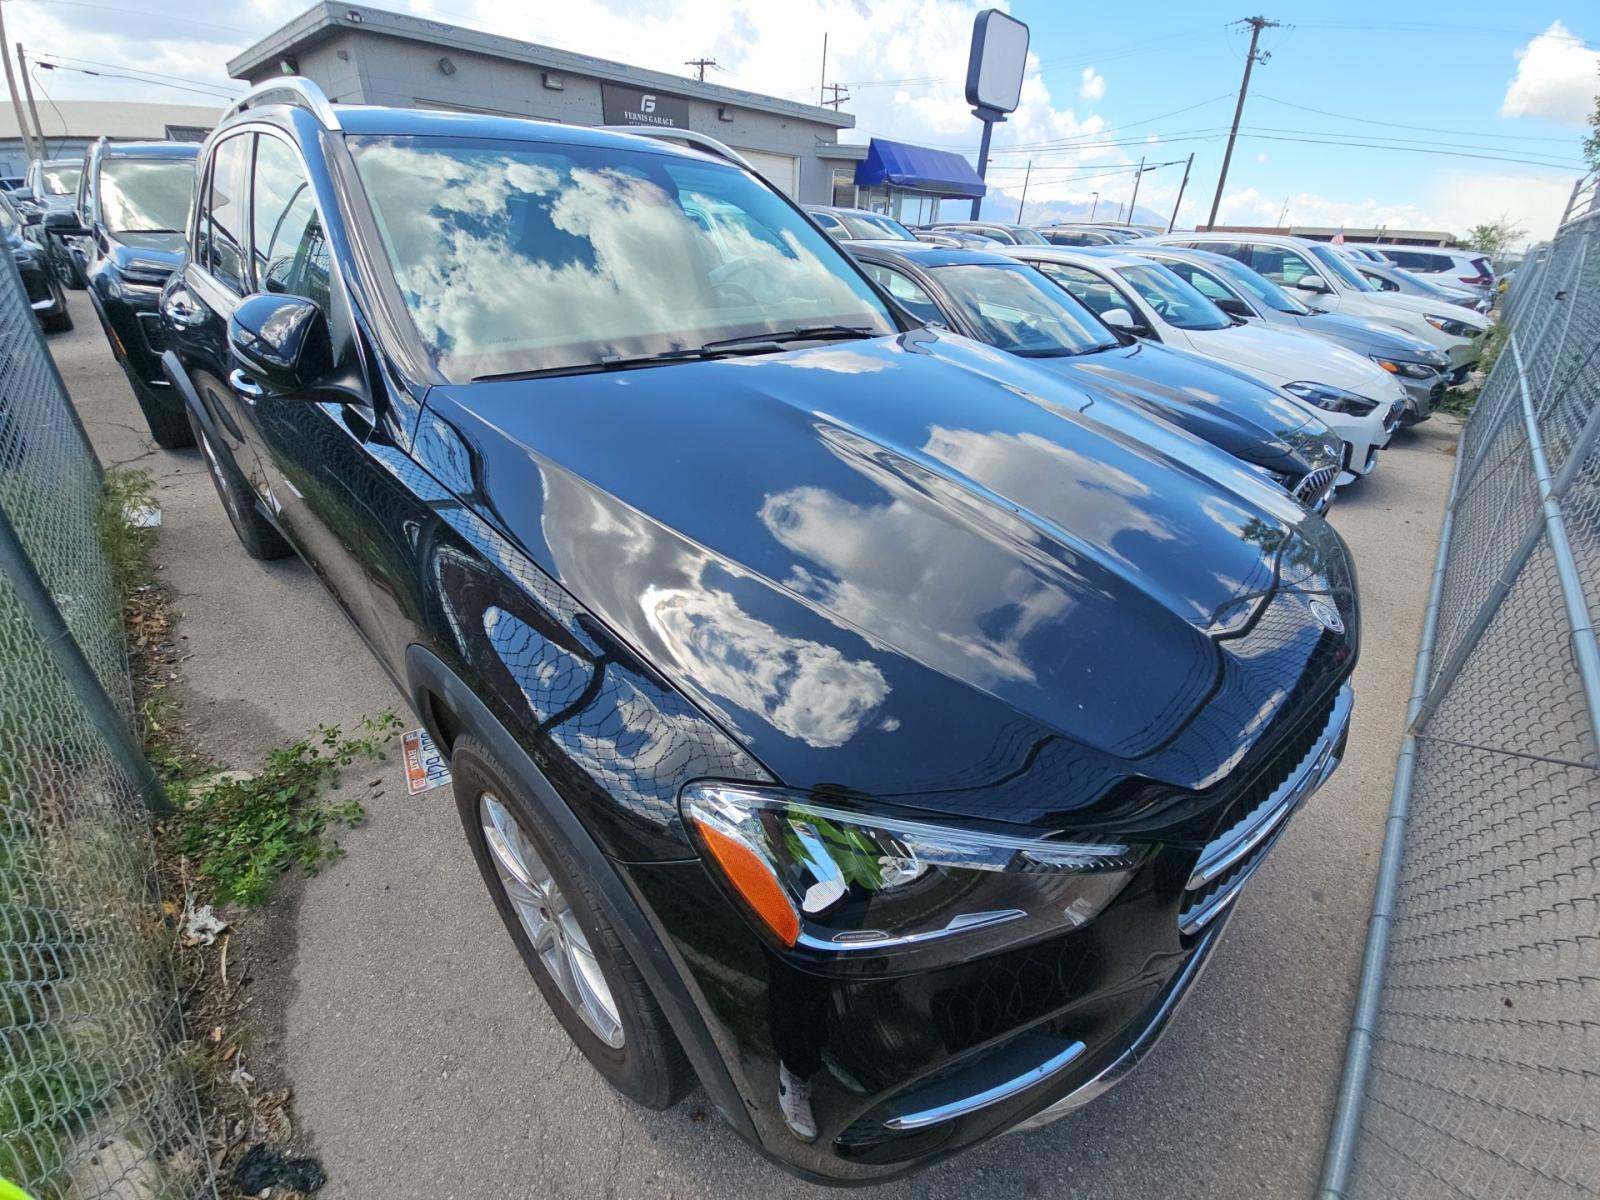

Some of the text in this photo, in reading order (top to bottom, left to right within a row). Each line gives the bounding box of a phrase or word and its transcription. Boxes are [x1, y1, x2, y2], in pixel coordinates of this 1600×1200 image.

[624, 111, 647, 122] VERNIS
[648, 116, 674, 126] GARAGE
[407, 749, 419, 770] UTAH
